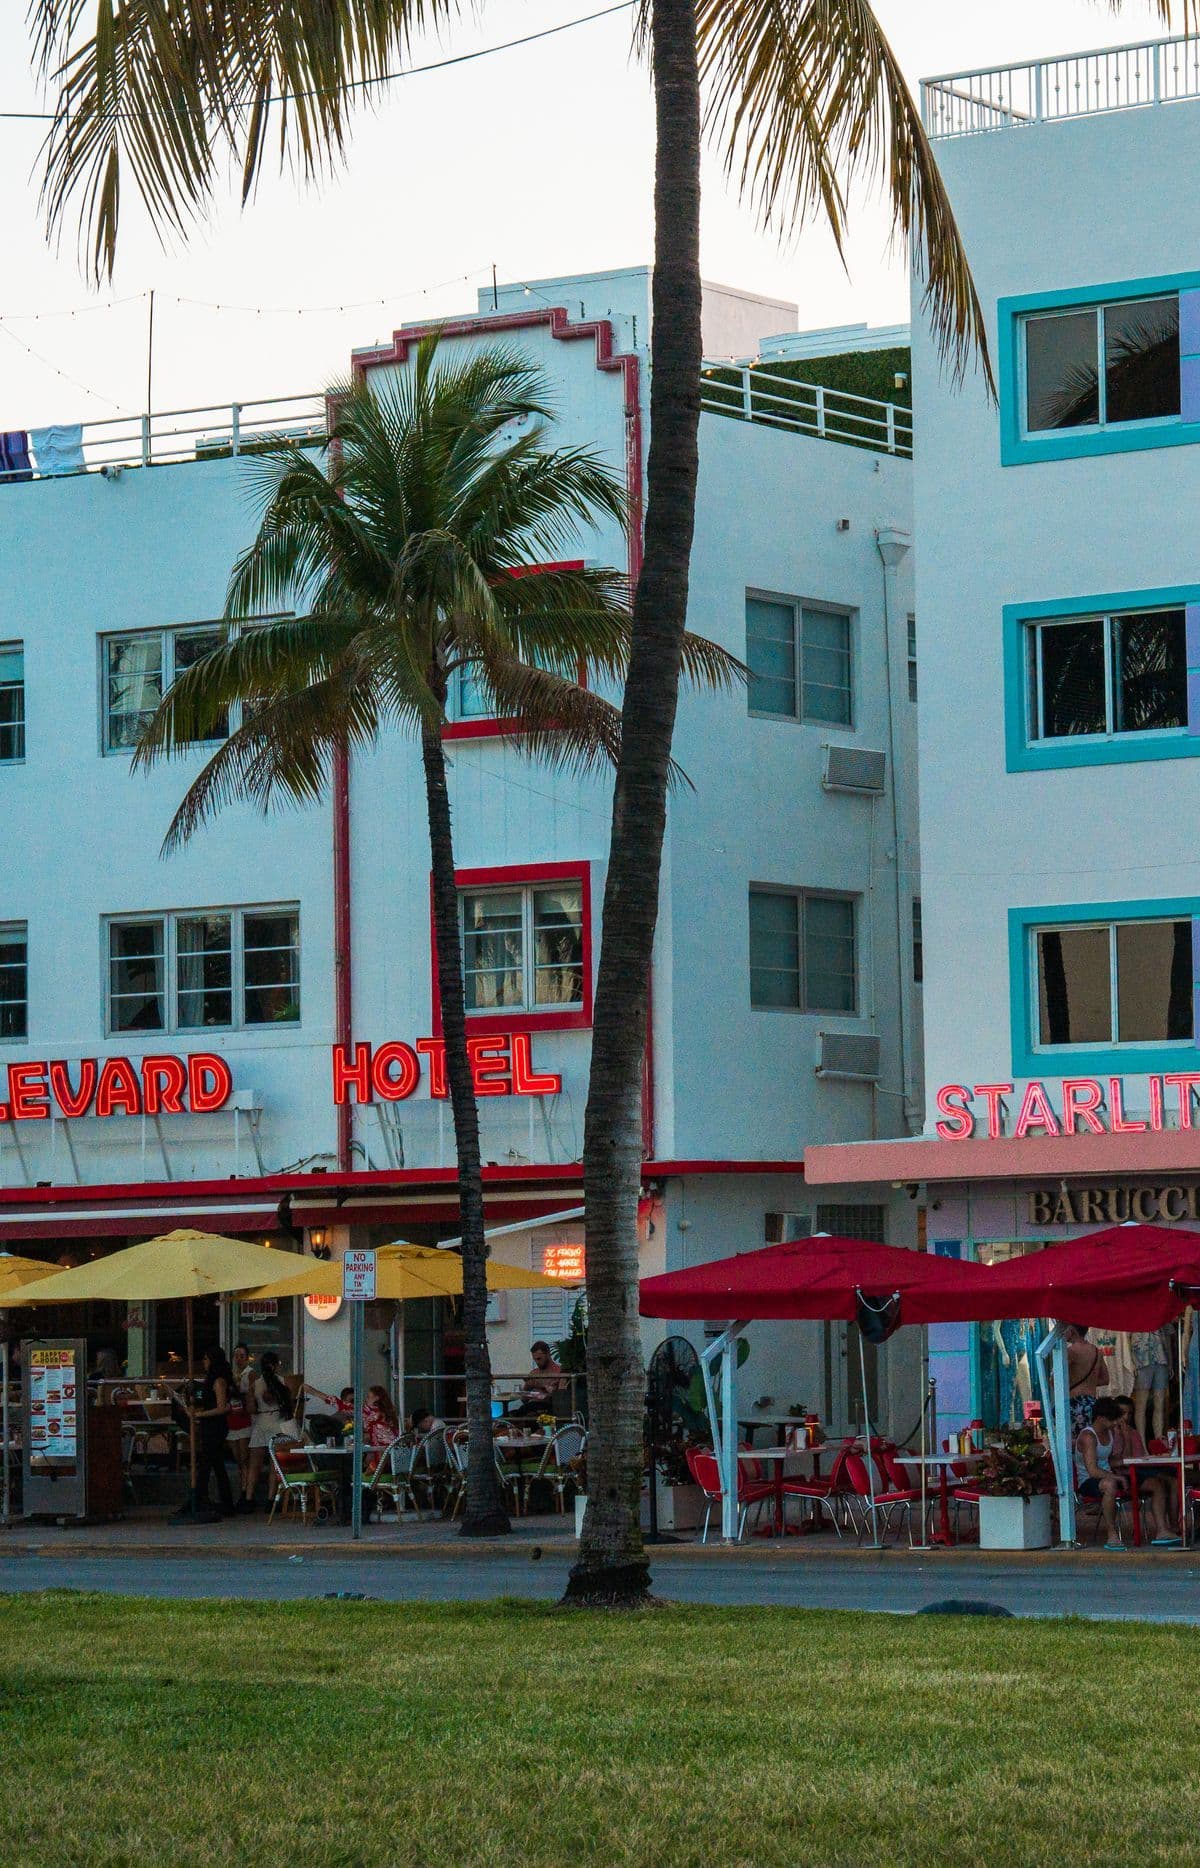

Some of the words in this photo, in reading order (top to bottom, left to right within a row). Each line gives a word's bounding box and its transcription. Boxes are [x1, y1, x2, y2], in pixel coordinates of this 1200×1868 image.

[0, 1053, 233, 1121] EVARD
[332, 1033, 562, 1105] HOTEL
[353, 1253, 366, 1262] NO
[346, 1263, 374, 1273] PARKING
